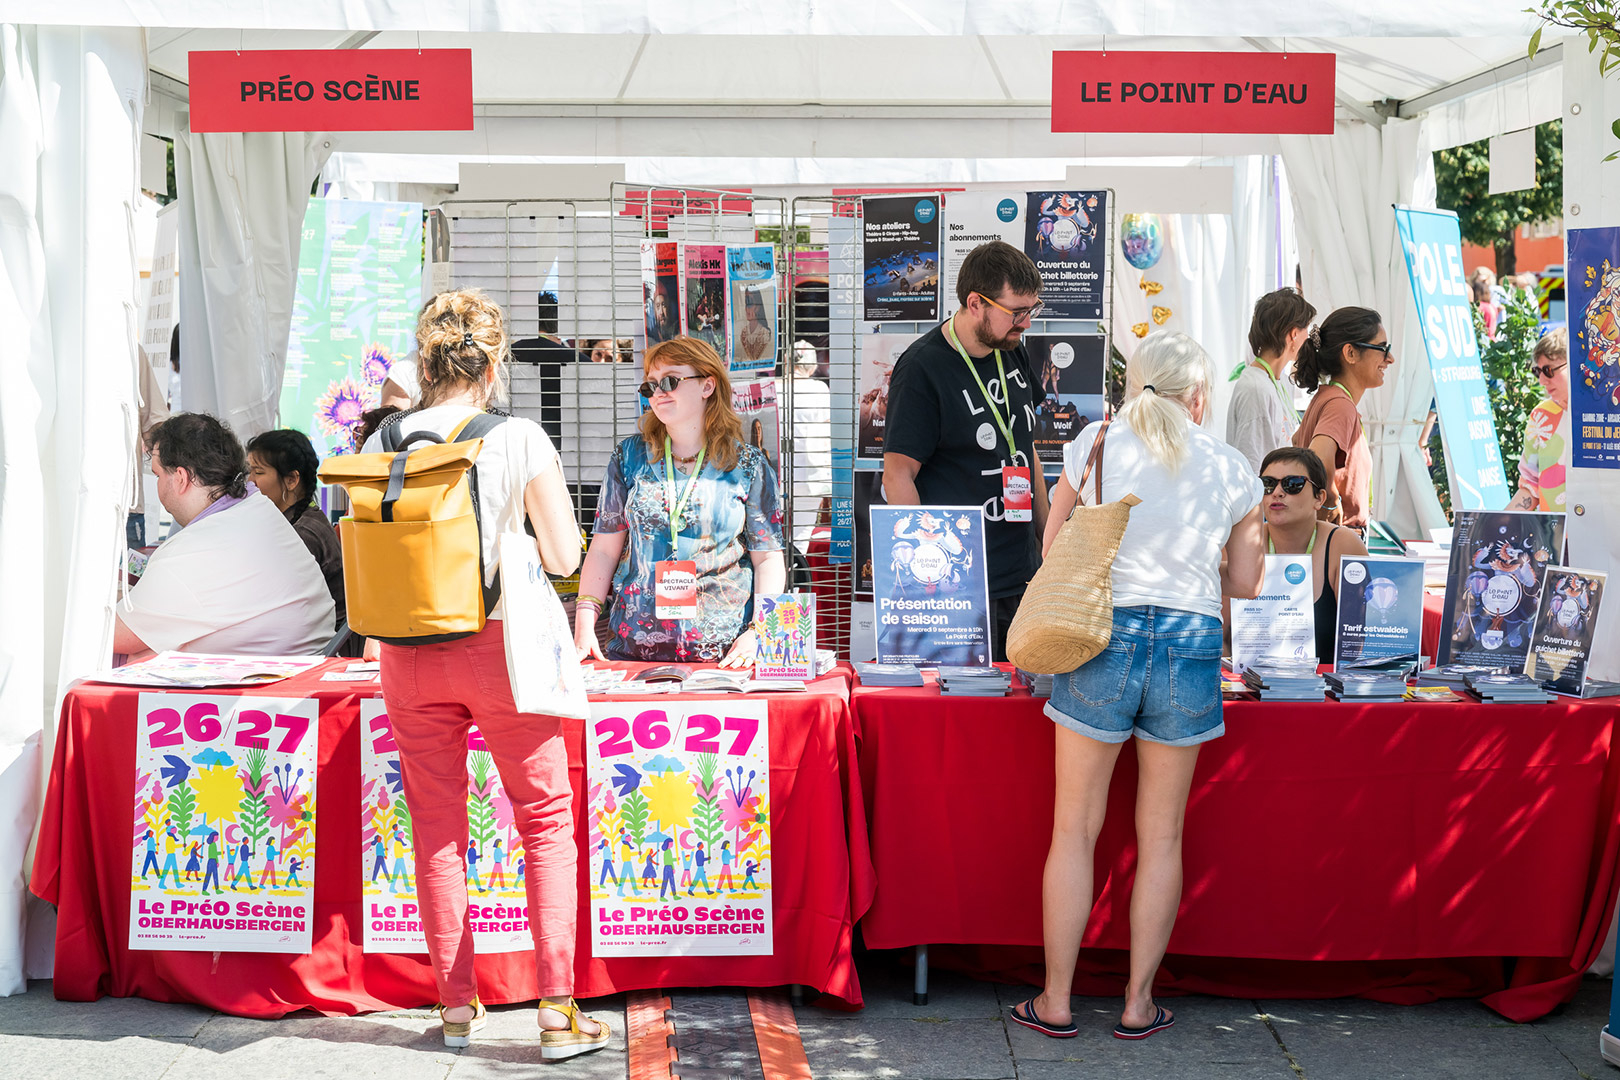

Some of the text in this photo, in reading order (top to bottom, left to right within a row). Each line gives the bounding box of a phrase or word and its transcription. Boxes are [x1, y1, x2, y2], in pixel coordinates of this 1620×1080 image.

[240, 74, 420, 102] PRÉO SCÈNE
[1081, 81, 1308, 104] LE POINT D'EAU
[866, 223, 881, 231] Nos
[949, 223, 964, 231] Nos
[949, 233, 1002, 242] abonnements
[688, 259, 721, 270] Alexis HK
[1037, 260, 1091, 269] Ouverture du
[1408, 241, 1466, 296] POLE
[1060, 272, 1099, 280] billetterie
[1426, 304, 1476, 360] SUD
[1053, 421, 1073, 430] Wolf
[1582, 426, 1604, 438] FESTIVAL
[1604, 426, 1612, 439] DU
[880, 597, 972, 610] Présentation
[784, 617, 796, 625] 27
[881, 612, 949, 625] de saison
[1343, 624, 1409, 634] Tarif ostwaldois
[1543, 634, 1582, 648] Ouverture du
[1535, 645, 1557, 654] guichet
[146, 702, 310, 754] 26/27
[594, 709, 760, 759] 26/27
[138, 895, 306, 918] Le PréO Scène
[371, 904, 397, 918] Le
[599, 905, 764, 922] Le PréO Scène
[138, 916, 306, 932] OBERHAUSBERGEN
[600, 923, 765, 936] OBERHAUSBERGEN
